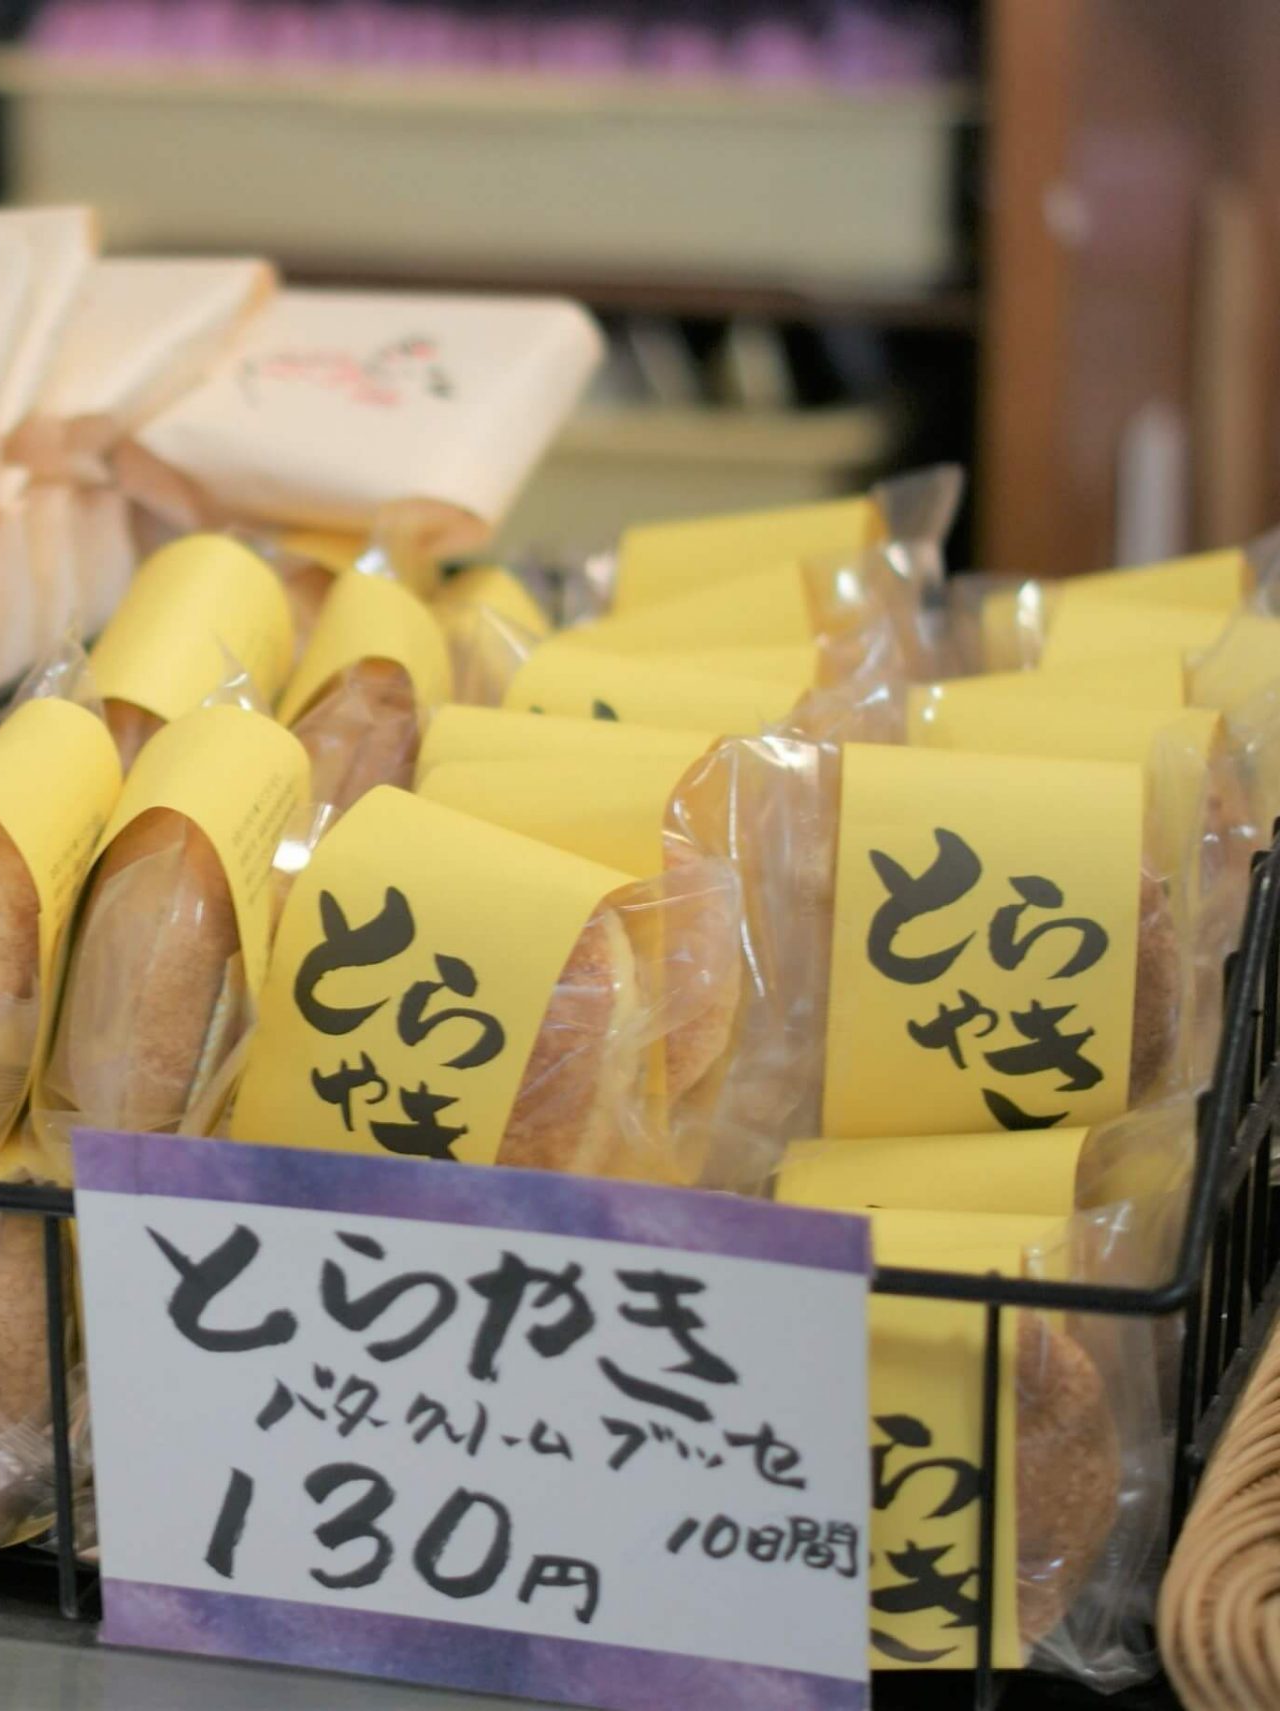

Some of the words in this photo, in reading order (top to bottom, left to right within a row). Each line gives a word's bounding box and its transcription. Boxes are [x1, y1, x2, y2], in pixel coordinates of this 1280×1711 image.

[293, 886, 506, 1071] とら
[866, 827, 1110, 986] とら
[906, 988, 1106, 1132] やき
[146, 1224, 740, 1424] とらやき
[204, 1462, 601, 1625] 130円
[871, 1413, 983, 1520] ら
[665, 1513, 860, 1580] 10日間
